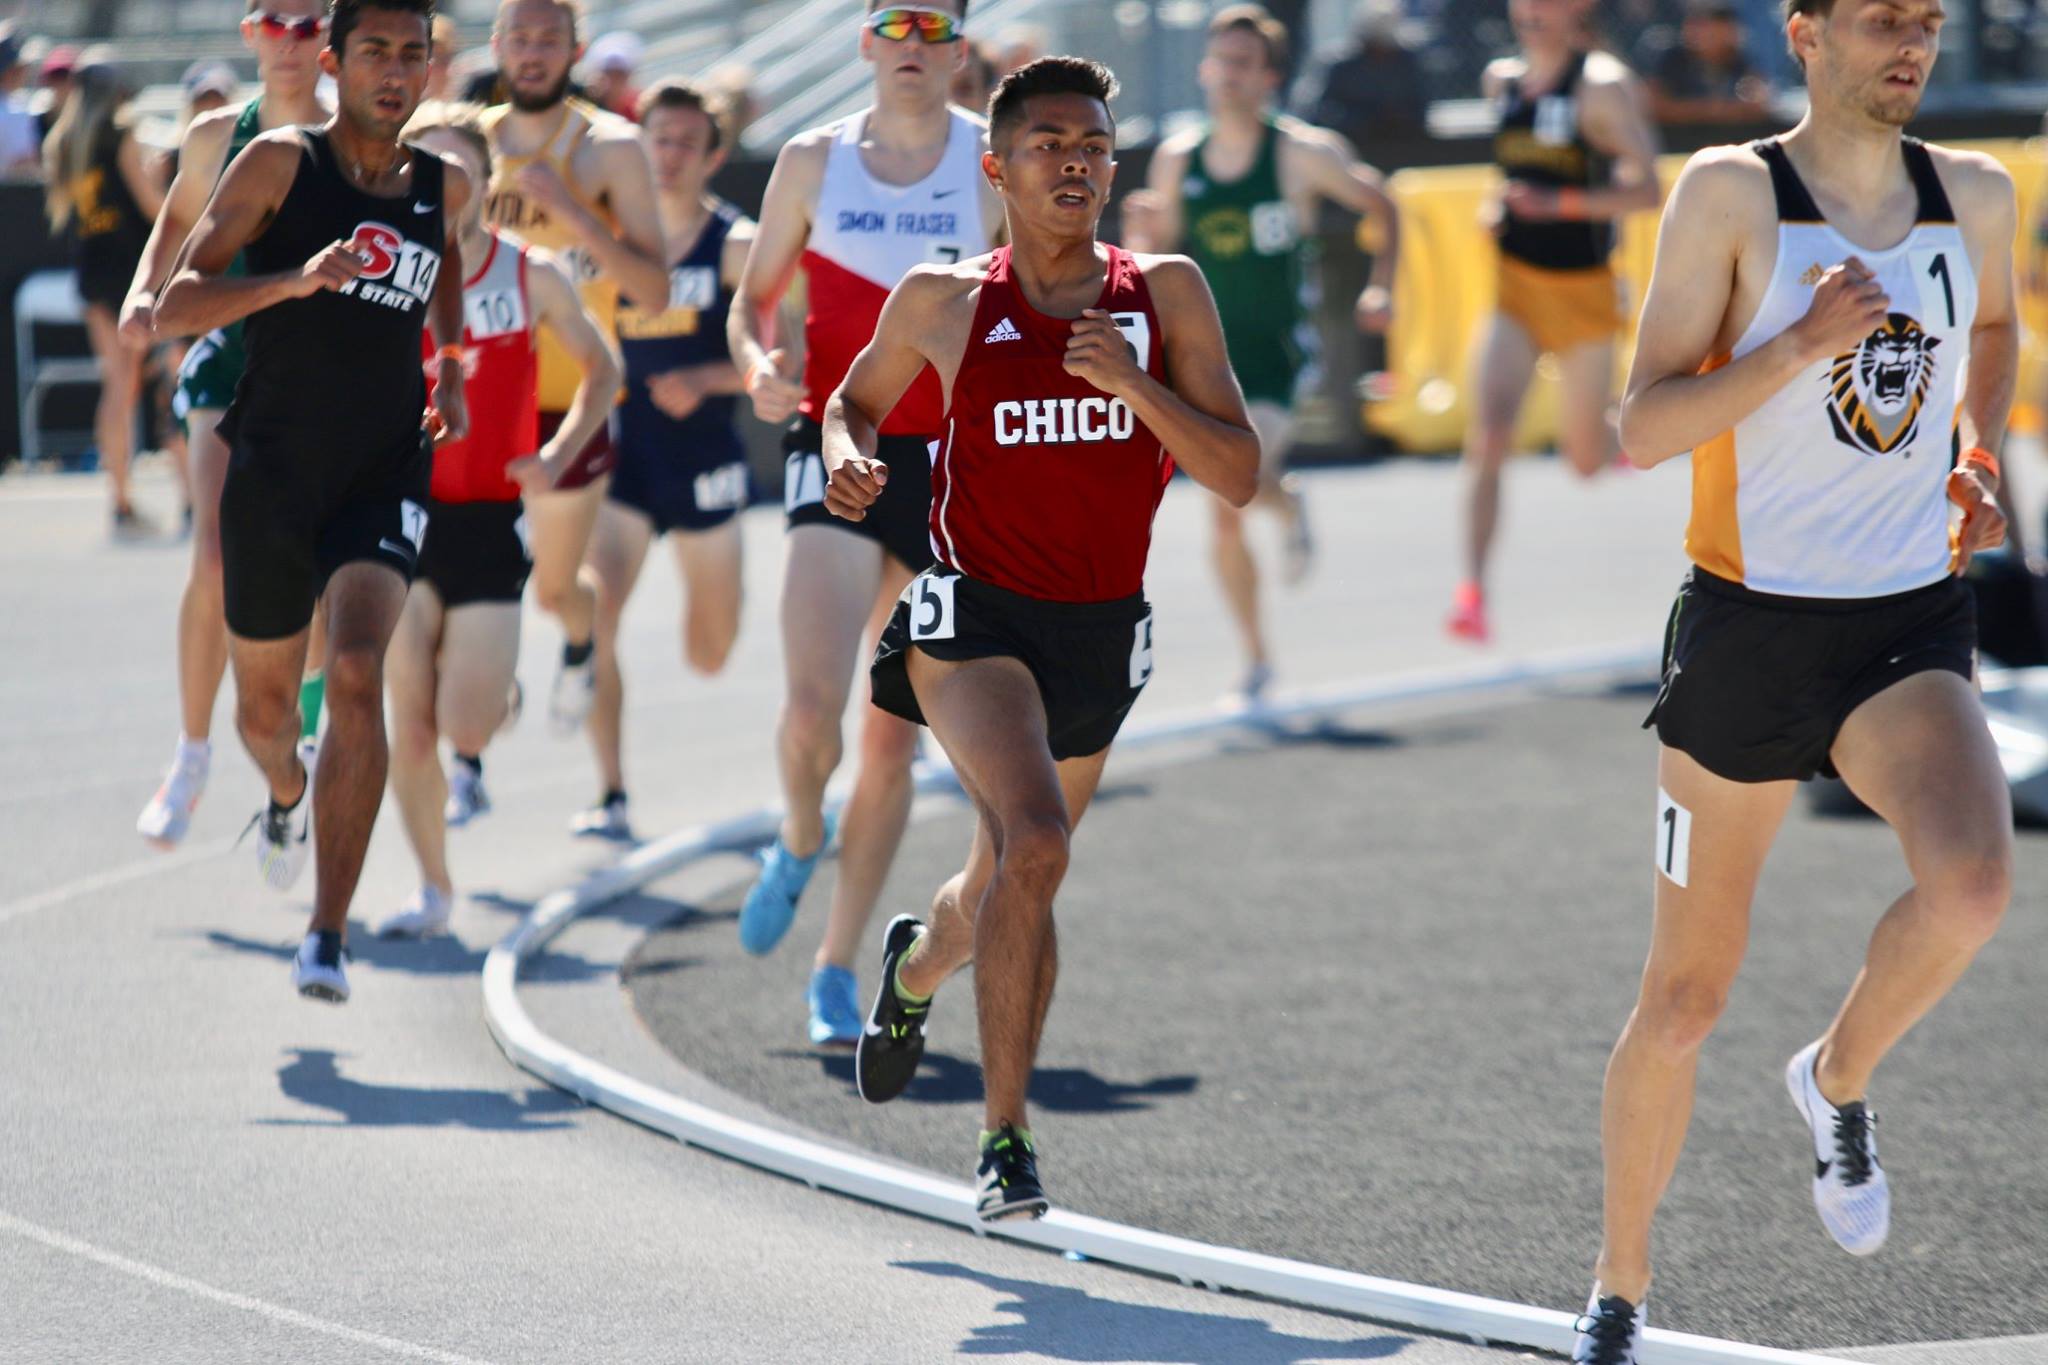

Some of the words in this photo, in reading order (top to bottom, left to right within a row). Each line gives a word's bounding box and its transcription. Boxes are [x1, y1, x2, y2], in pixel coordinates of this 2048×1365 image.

[837, 209, 885, 232] SIMON
[896, 211, 957, 236] FRASER
[352, 221, 403, 280] S
[410, 250, 437, 296] 14
[359, 281, 414, 312] STATE
[478, 292, 514, 332] 10
[1928, 252, 1955, 328] 1
[985, 331, 1022, 344] adidas
[993, 397, 1134, 446] CHICO
[917, 577, 943, 636] 5
[1664, 806, 1677, 874] 1
